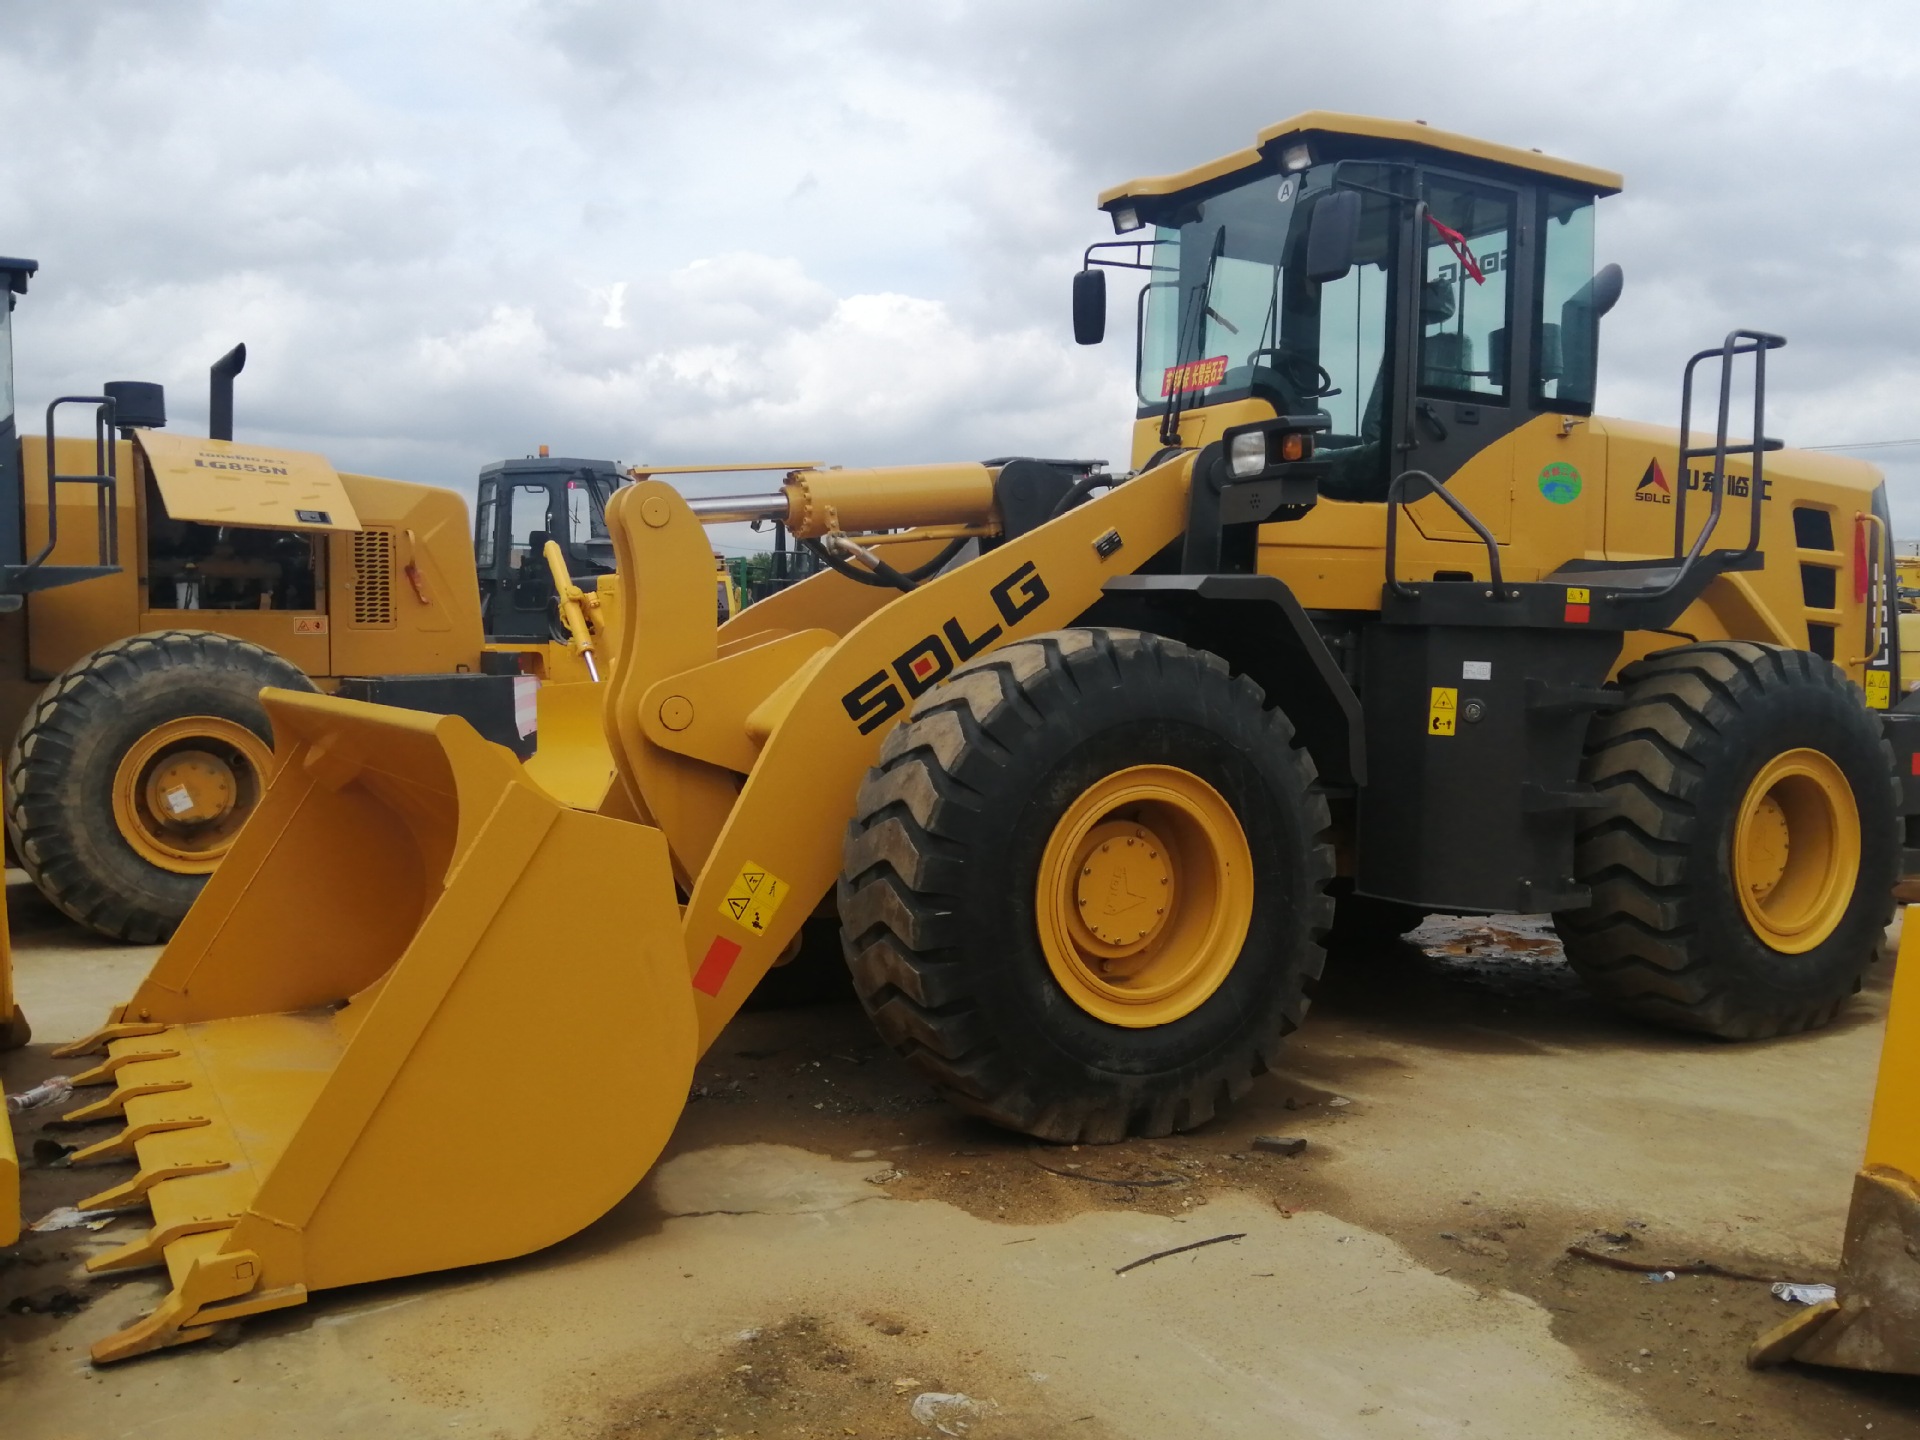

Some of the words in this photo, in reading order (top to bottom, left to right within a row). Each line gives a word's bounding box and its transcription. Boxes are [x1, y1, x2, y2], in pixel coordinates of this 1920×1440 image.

[1280, 184, 1290, 200] A
[194, 459, 288, 476] LG855N
[1635, 491, 1671, 504] SDLG
[841, 560, 1050, 736] SDLG
